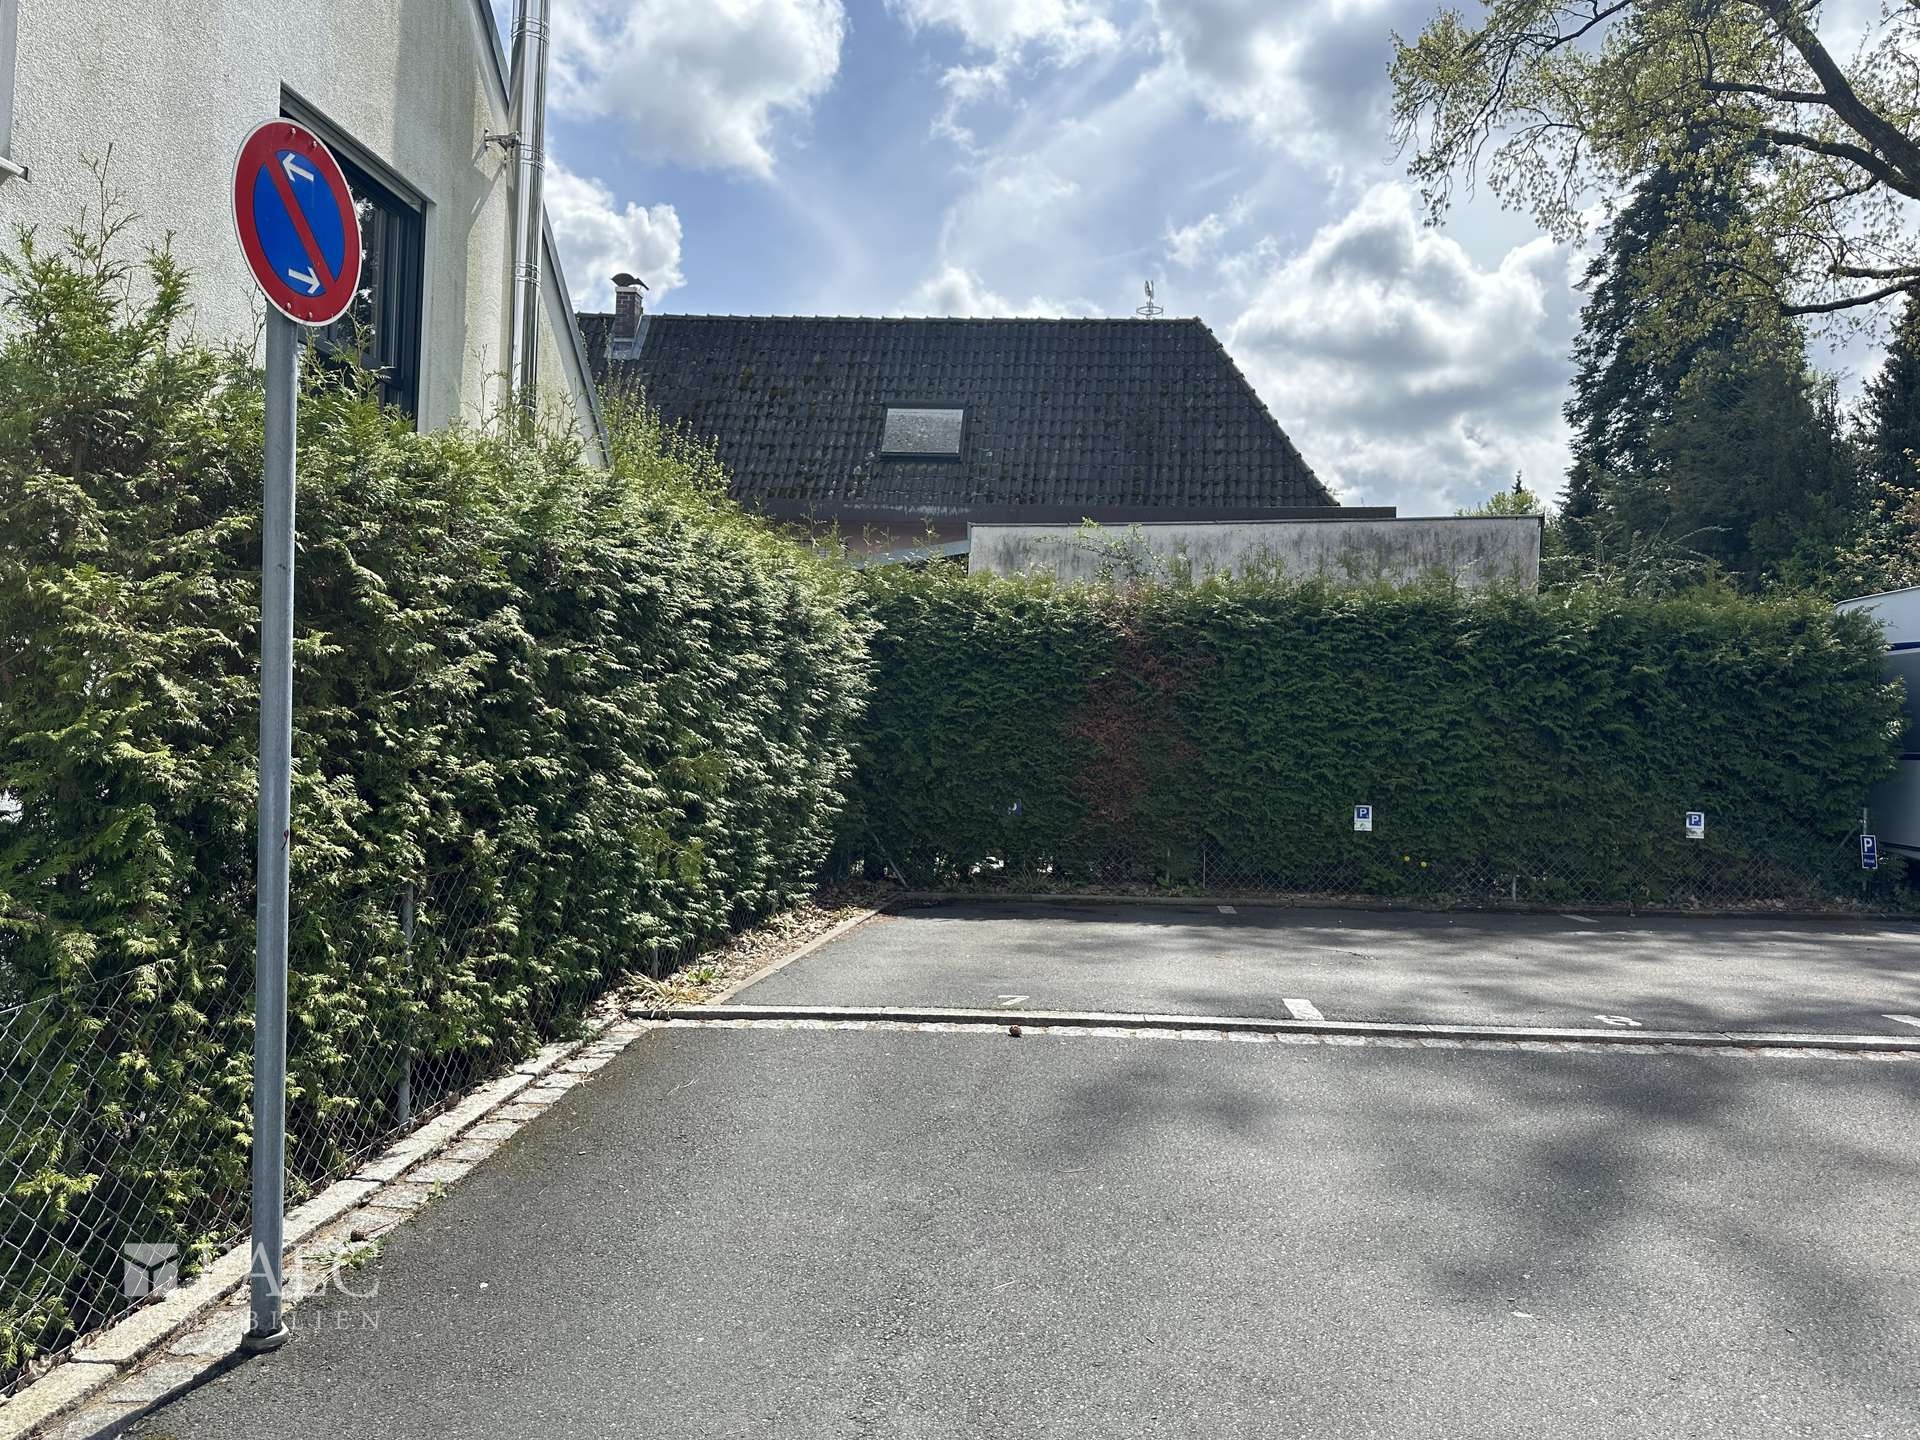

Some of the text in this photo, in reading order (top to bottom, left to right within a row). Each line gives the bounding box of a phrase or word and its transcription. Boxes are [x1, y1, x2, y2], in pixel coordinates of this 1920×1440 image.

[1360, 808, 1367, 817] P
[1691, 815, 1699, 824] P
[1863, 838, 1872, 852] P
[998, 995, 1030, 1005] 7
